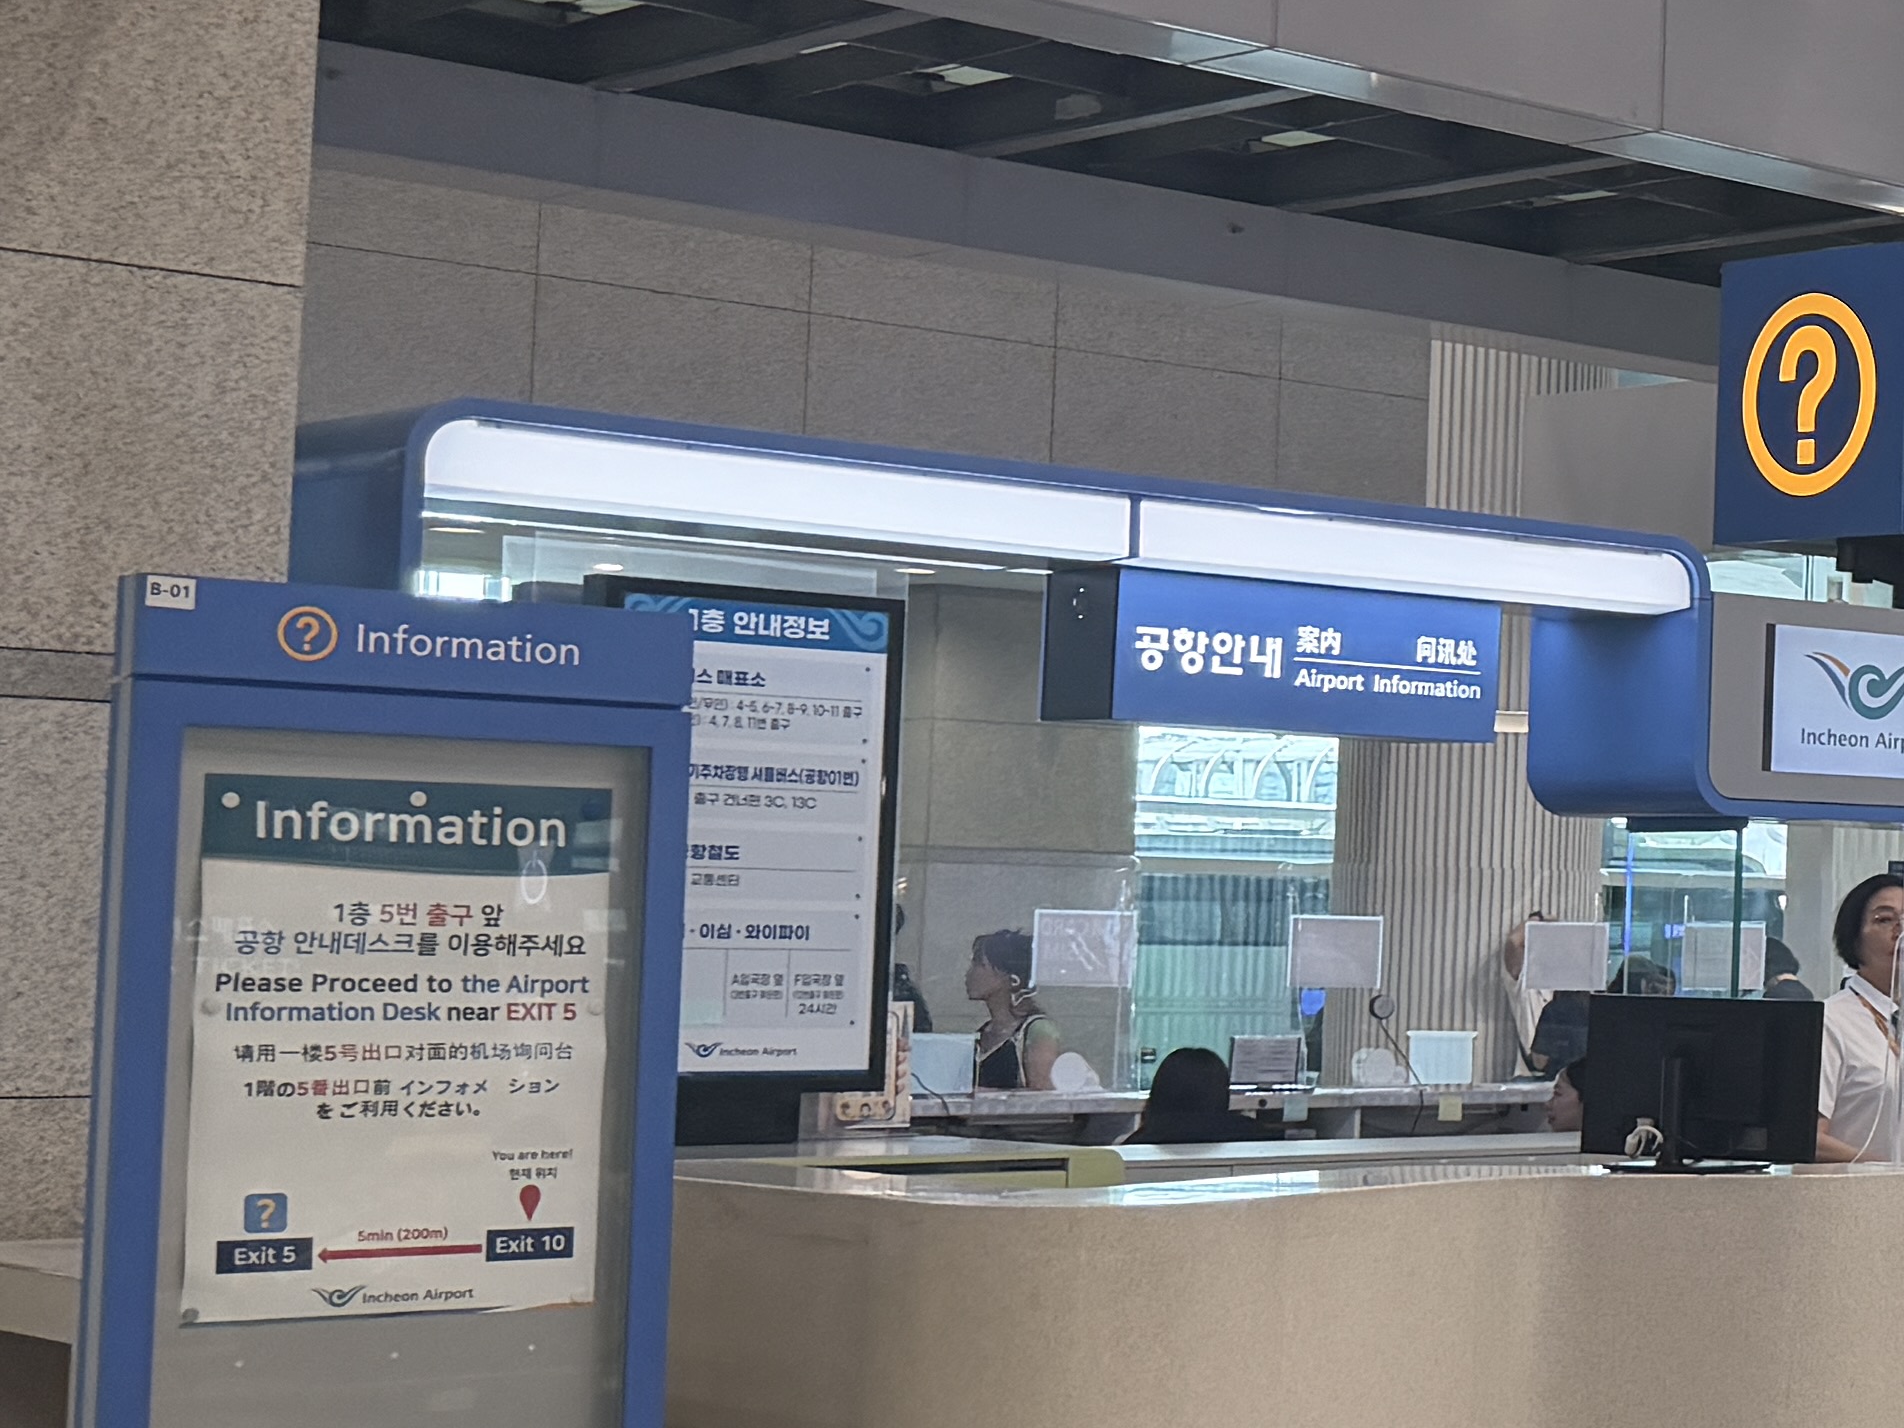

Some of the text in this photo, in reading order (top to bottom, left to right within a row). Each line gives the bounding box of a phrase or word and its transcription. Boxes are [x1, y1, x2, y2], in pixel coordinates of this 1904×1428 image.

[149, 582, 190, 600] B-01
[688, 608, 831, 641] 1층 안내정보
[356, 623, 581, 666] Information
[1296, 625, 1342, 656] 案内
[1134, 624, 1283, 679] 공항안내
[717, 670, 766, 687] 매표소
[1294, 670, 1482, 700] Airport Information
[1800, 728, 1869, 749] Incheon
[791, 796, 818, 810] 13C
[255, 799, 568, 849] Information
[333, 902, 505, 928] 1층 5번 출구 앞
[699, 923, 811, 941] 이심 와이파이
[234, 930, 587, 958] 공항 안내데스크를 이용해주세요
[215, 974, 590, 999] Please Proceed to the Airport
[226, 1001, 577, 1022] Information Desk near EXIT 5
[719, 1046, 798, 1058] Incheon Airport
[492, 1150, 515, 1161] You
[518, 1151, 539, 1161] are
[535, 1167, 558, 1180] 위치
[357, 1226, 449, 1243] 5min (200m)
[495, 1235, 567, 1254] Exit 10
[233, 1246, 298, 1266] Exit 5
[361, 1287, 474, 1304] Incheon Airport
